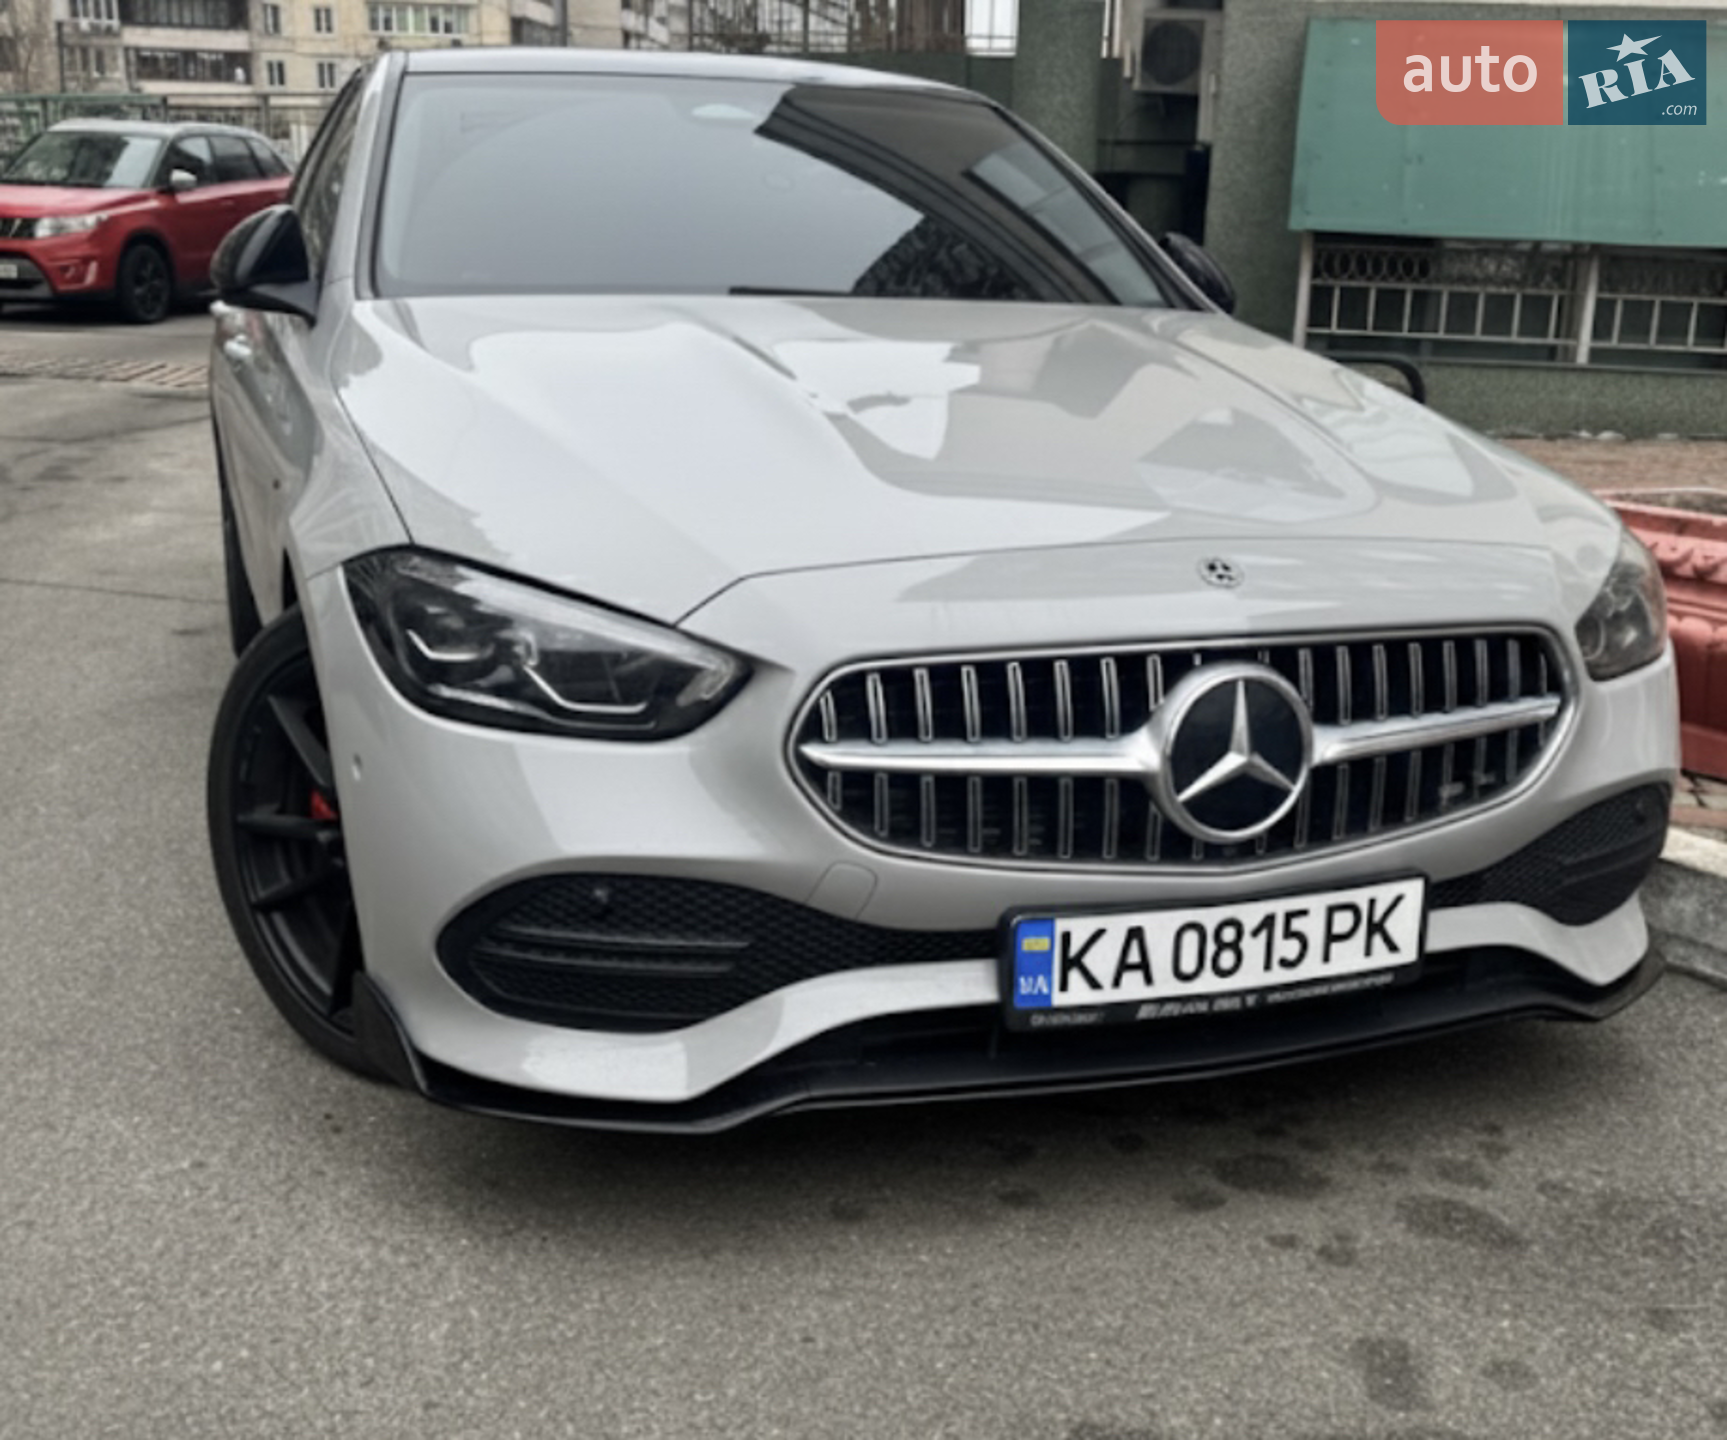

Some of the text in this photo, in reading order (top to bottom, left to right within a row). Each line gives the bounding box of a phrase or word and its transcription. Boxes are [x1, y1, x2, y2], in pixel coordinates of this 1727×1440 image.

[1058, 893, 1406, 993] KA 0815 PK
[1019, 974, 1049, 996] UA
